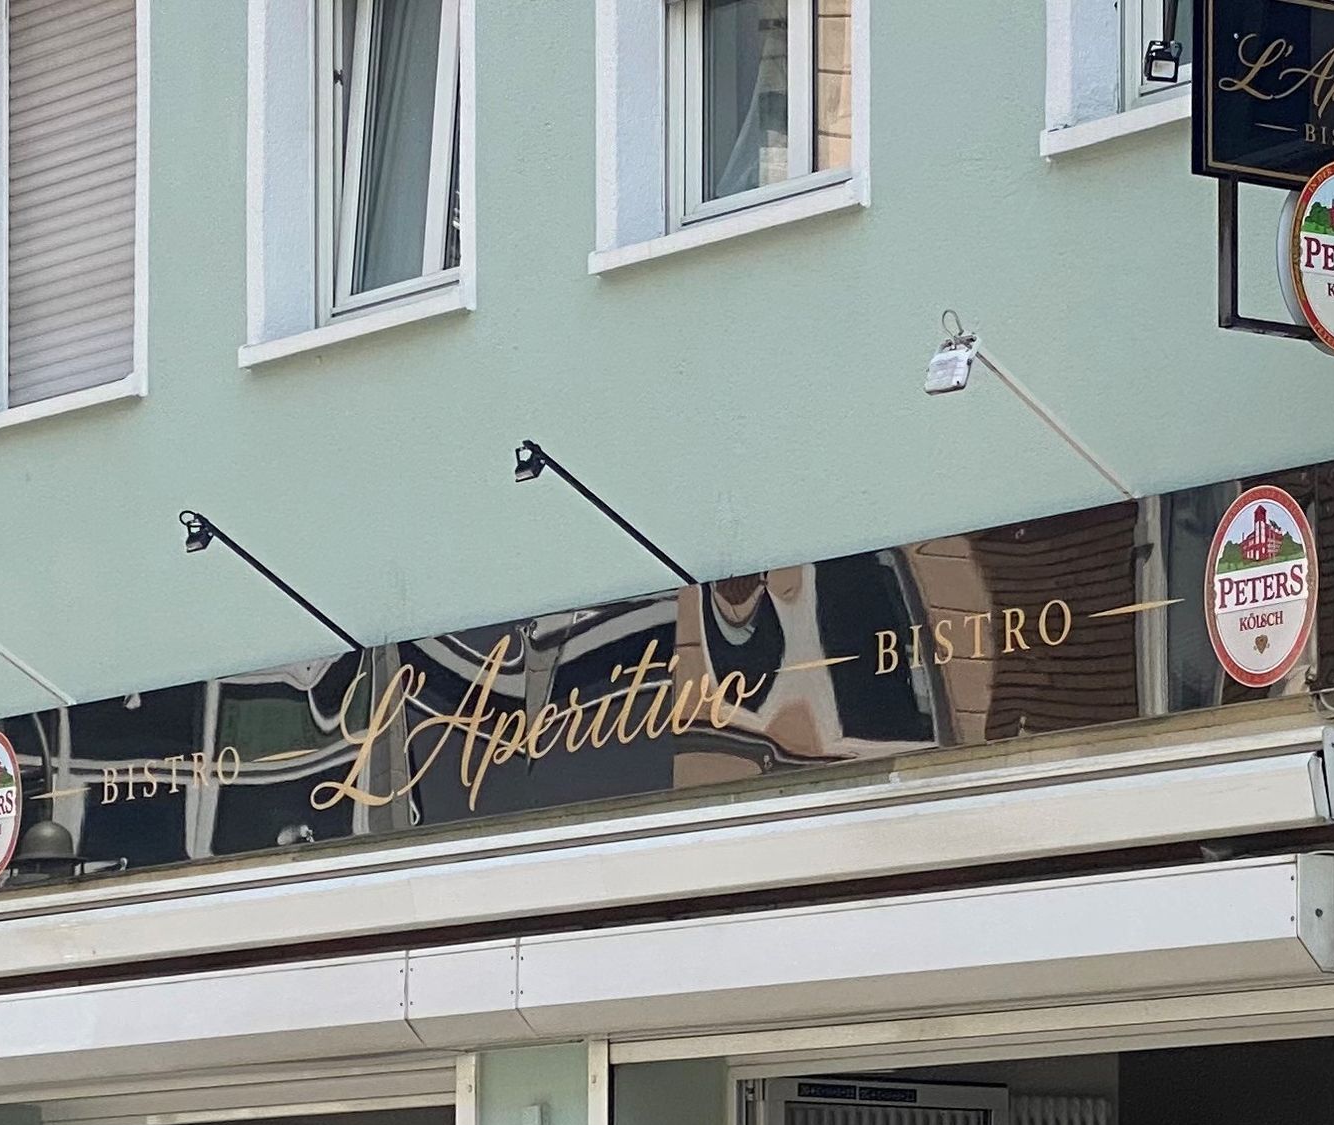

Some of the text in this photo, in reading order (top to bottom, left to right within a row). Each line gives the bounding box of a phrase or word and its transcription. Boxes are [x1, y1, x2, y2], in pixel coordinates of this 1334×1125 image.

[1218, 563, 1304, 610] PETERS
[1239, 611, 1284, 632] KÖLSCH
[100, 599, 1073, 811] BISTRO L'Aperitivo BISTRO
